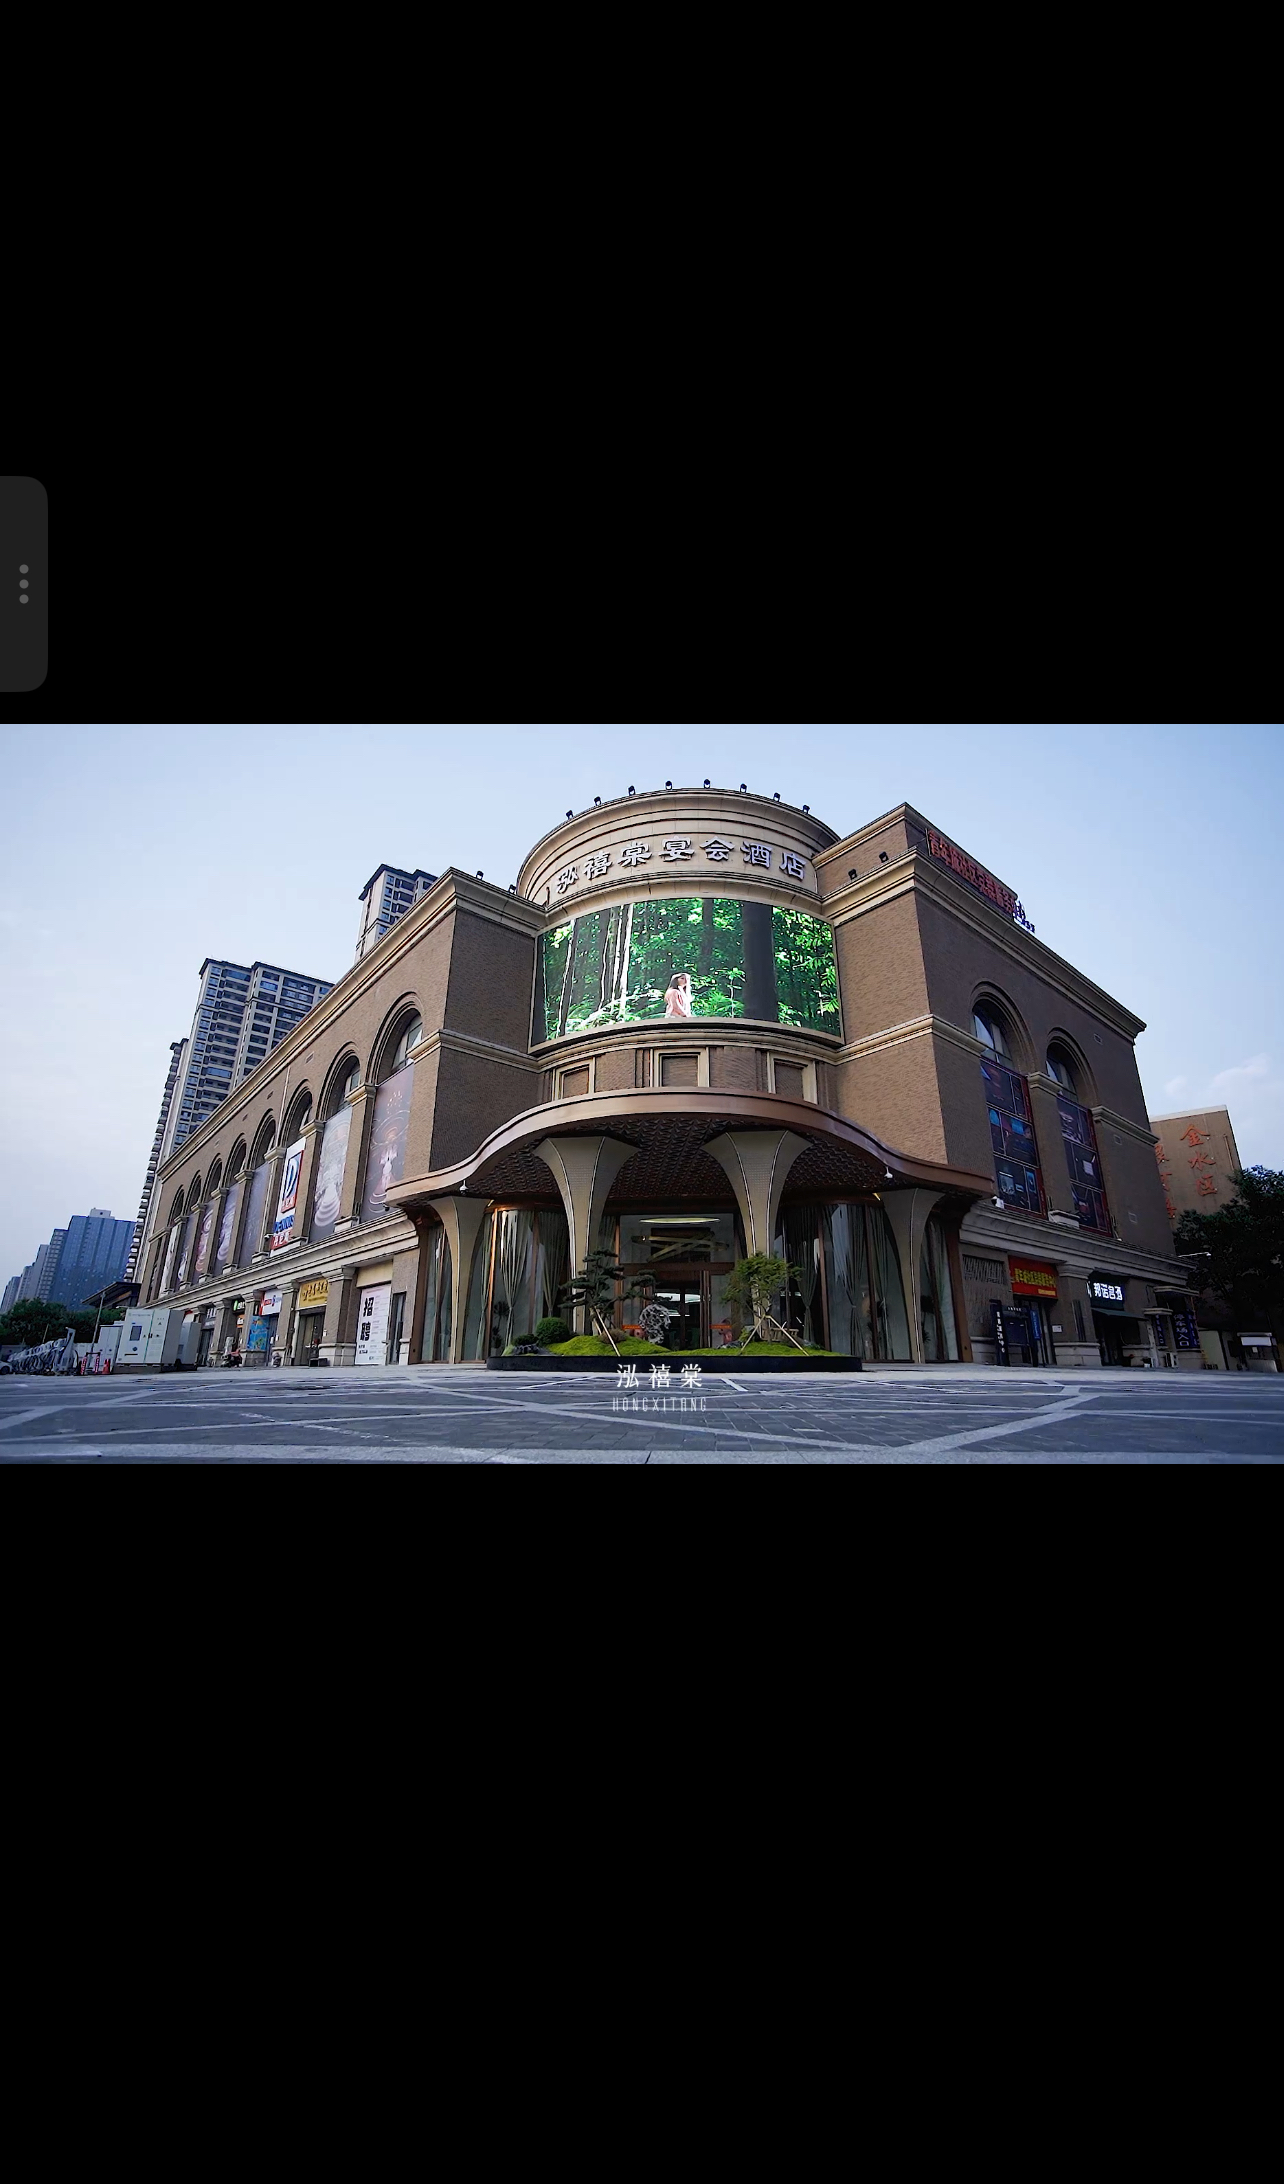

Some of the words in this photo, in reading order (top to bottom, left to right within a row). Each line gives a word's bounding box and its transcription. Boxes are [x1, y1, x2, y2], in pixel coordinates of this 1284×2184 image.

[555, 835, 807, 894] 泓禧棠宴会酒店
[1180, 1123, 1219, 1196] 金水区
[1093, 1282, 1123, 1301] 邦诺名酒
[360, 1297, 375, 1342] 招聘
[1173, 1313, 1189, 1347] 停车场入口
